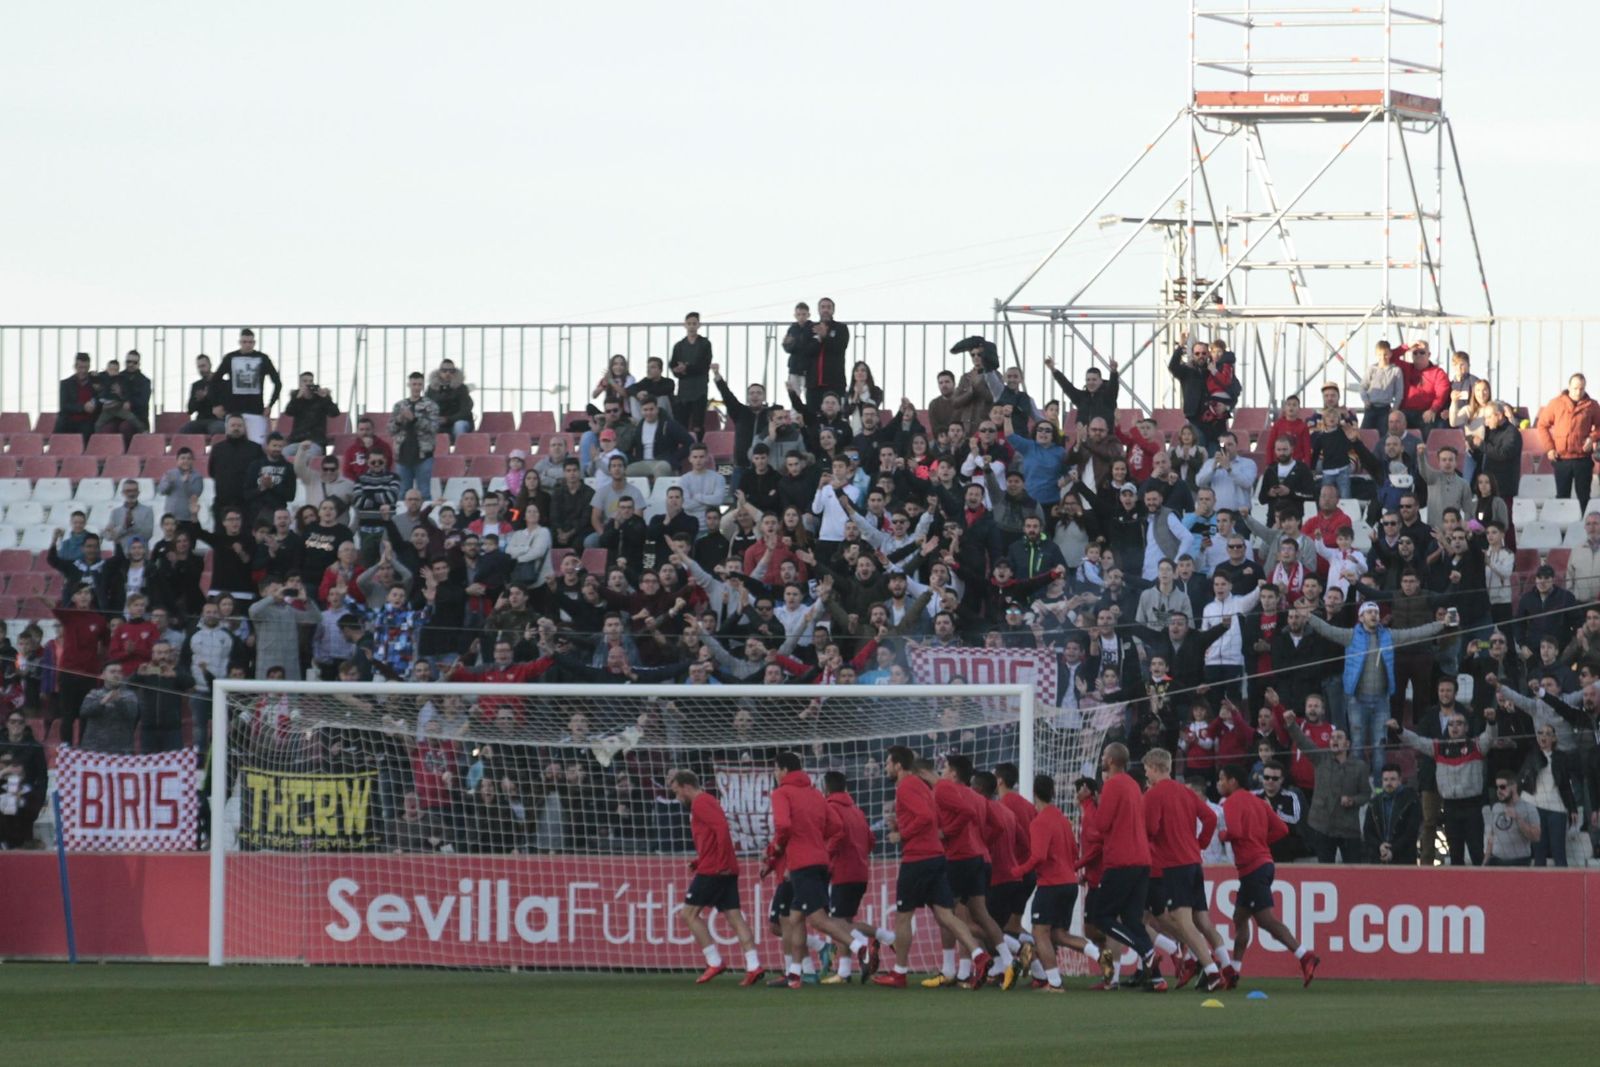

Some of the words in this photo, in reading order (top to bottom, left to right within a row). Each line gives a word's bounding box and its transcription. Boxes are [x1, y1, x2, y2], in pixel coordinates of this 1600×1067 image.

[1263, 92, 1296, 104] Layher
[80, 771, 180, 830] BIRIS
[716, 772, 775, 813] SANC
[325, 877, 559, 943] Sevilla
[1204, 880, 1485, 954] SOP.com
